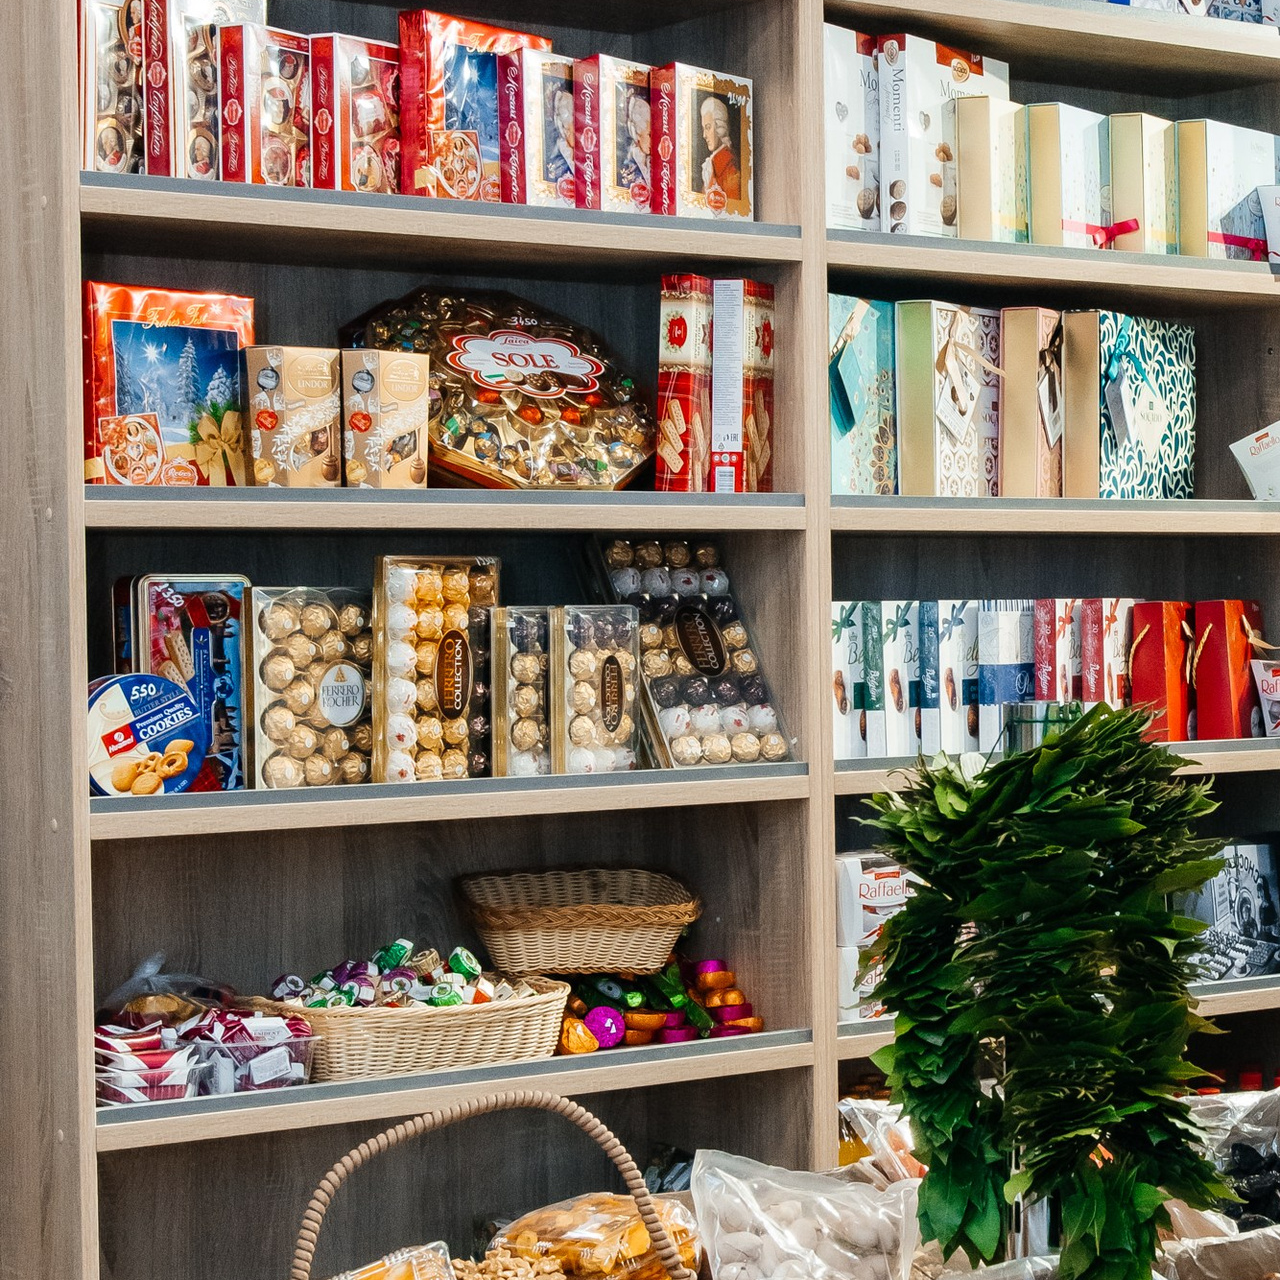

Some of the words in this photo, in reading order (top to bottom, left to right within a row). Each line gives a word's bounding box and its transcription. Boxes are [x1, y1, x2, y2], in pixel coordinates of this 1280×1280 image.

[892, 67, 905, 133] Momenti
[491, 351, 561, 369] SOLE
[297, 379, 328, 389] LINDOR
[391, 383, 419, 393] LINDOR
[1248, 435, 1280, 457] Raffaello
[694, 612, 719, 670] COLLECTION
[444, 638, 455, 709] FERRERO
[454, 638, 462, 710] COLLECTION
[131, 682, 157, 700] 550
[322, 684, 360, 695] FERRERO
[322, 695, 360, 708] ROCHER
[610, 664, 618, 725] FERRERO
[135, 712, 164, 730] Premium
[164, 701, 185, 717] Quality
[138, 706, 193, 740] COOKIES
